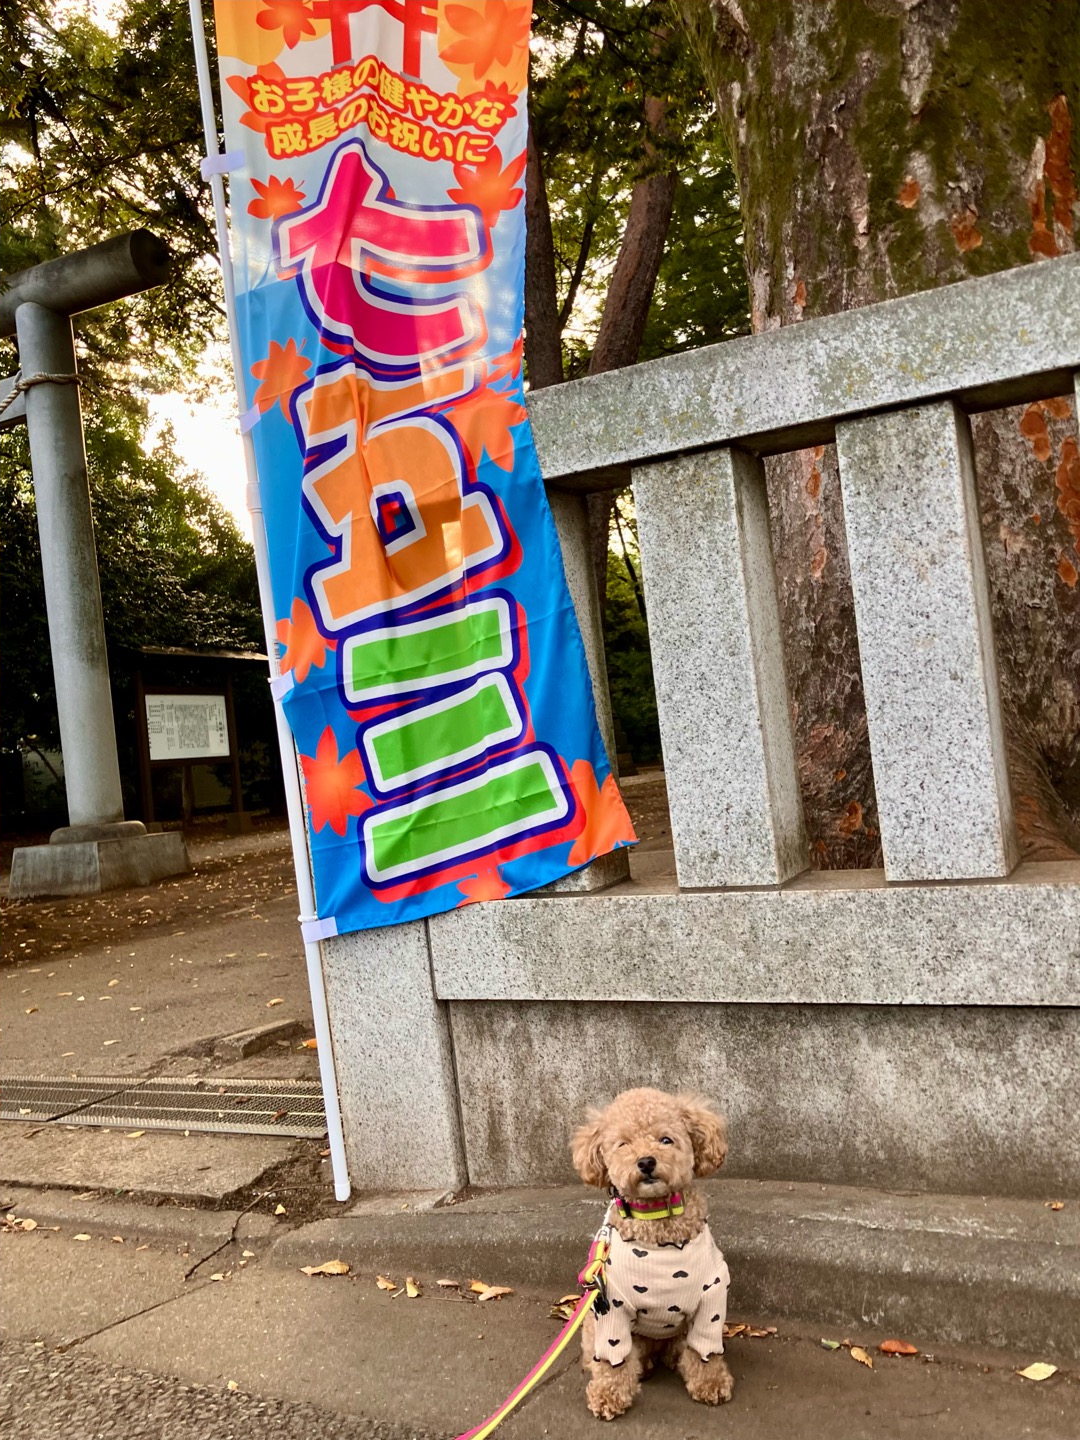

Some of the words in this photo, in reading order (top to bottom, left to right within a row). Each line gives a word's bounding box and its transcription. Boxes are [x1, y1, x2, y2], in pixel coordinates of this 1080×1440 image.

[252, 58, 507, 130] お子様の健やかな
[269, 101, 494, 163] 成長のお祝いに
[274, 139, 572, 888] 七五三
